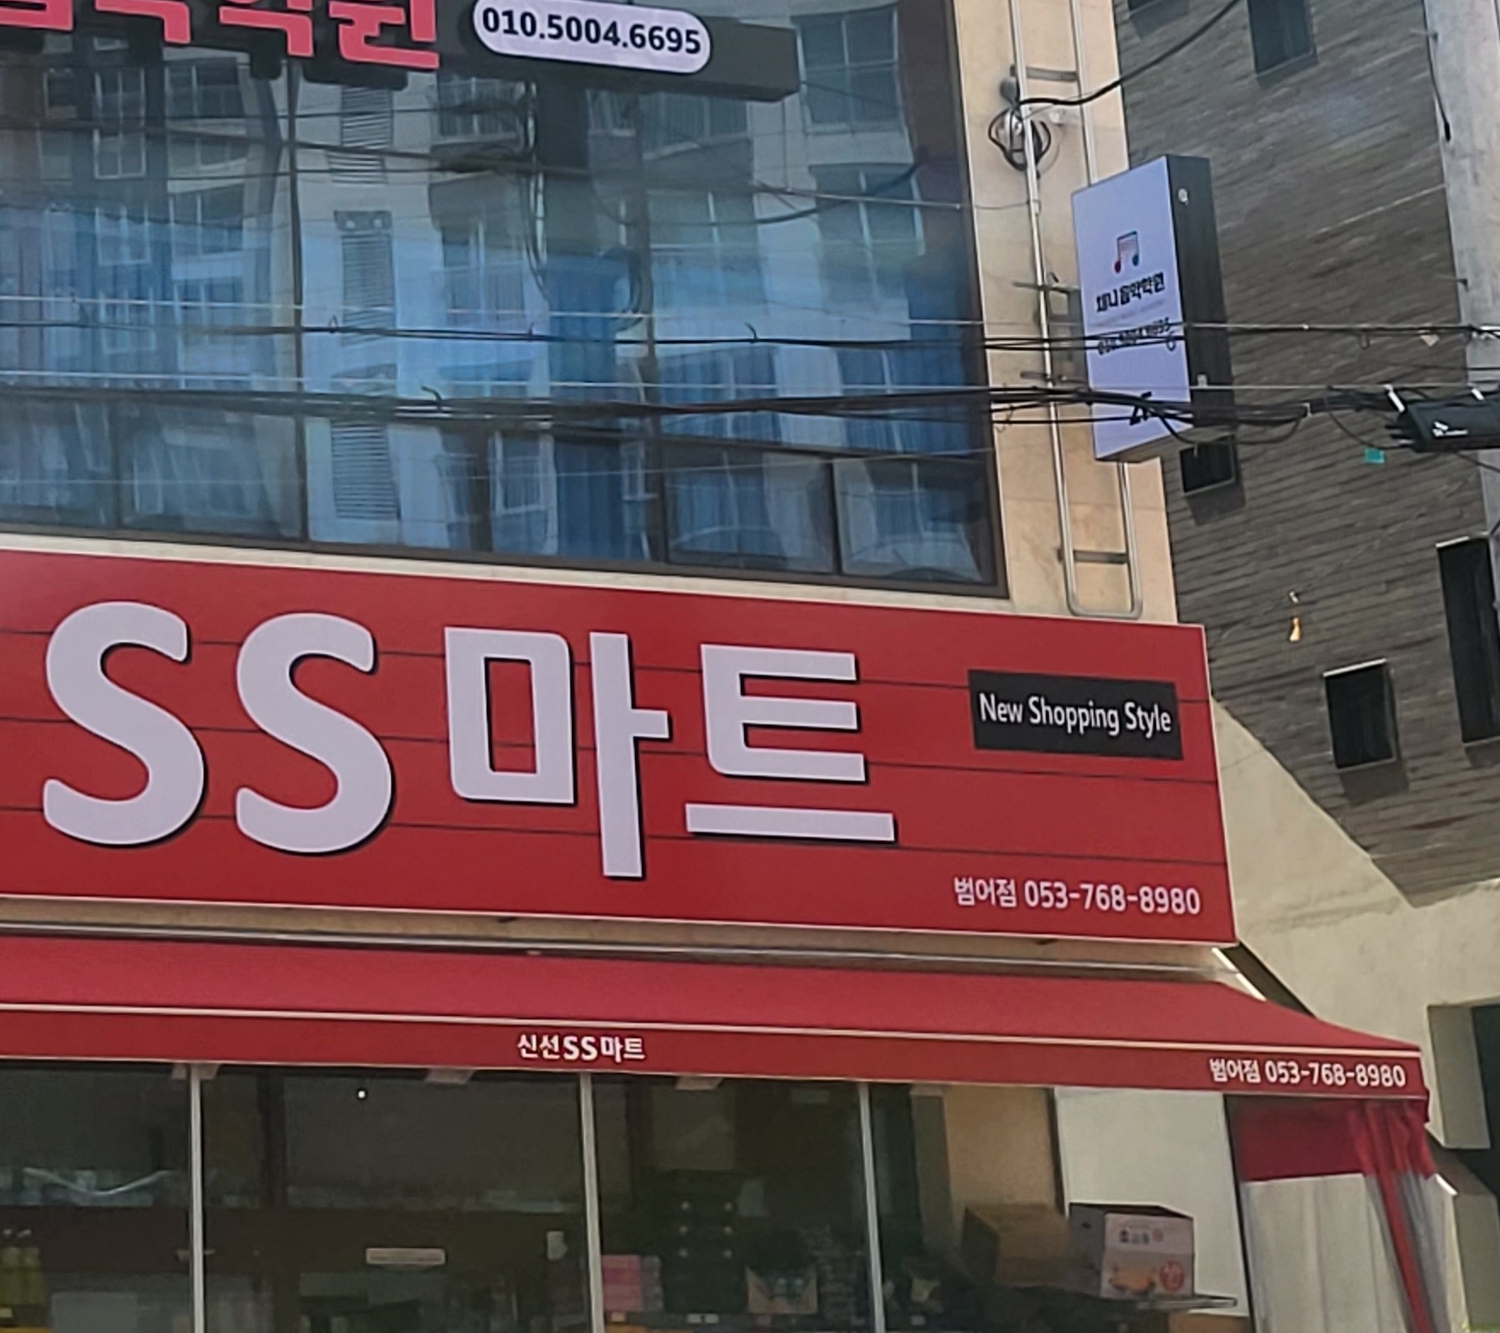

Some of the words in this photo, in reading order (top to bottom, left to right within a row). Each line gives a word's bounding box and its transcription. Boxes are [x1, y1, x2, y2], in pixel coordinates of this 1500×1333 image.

[481, 7, 702, 57] 010.5004.6695
[979, 693, 1023, 723] New
[1028, 696, 1120, 736] Shopping
[1124, 701, 1172, 739] Style
[954, 877, 1017, 908] 범어점
[1024, 880, 1201, 915] 053-768-8980
[517, 1033, 646, 1063] 신선SS마트
[1209, 1058, 1262, 1084] 범어점
[1264, 1060, 1406, 1088] 053-768-8980
